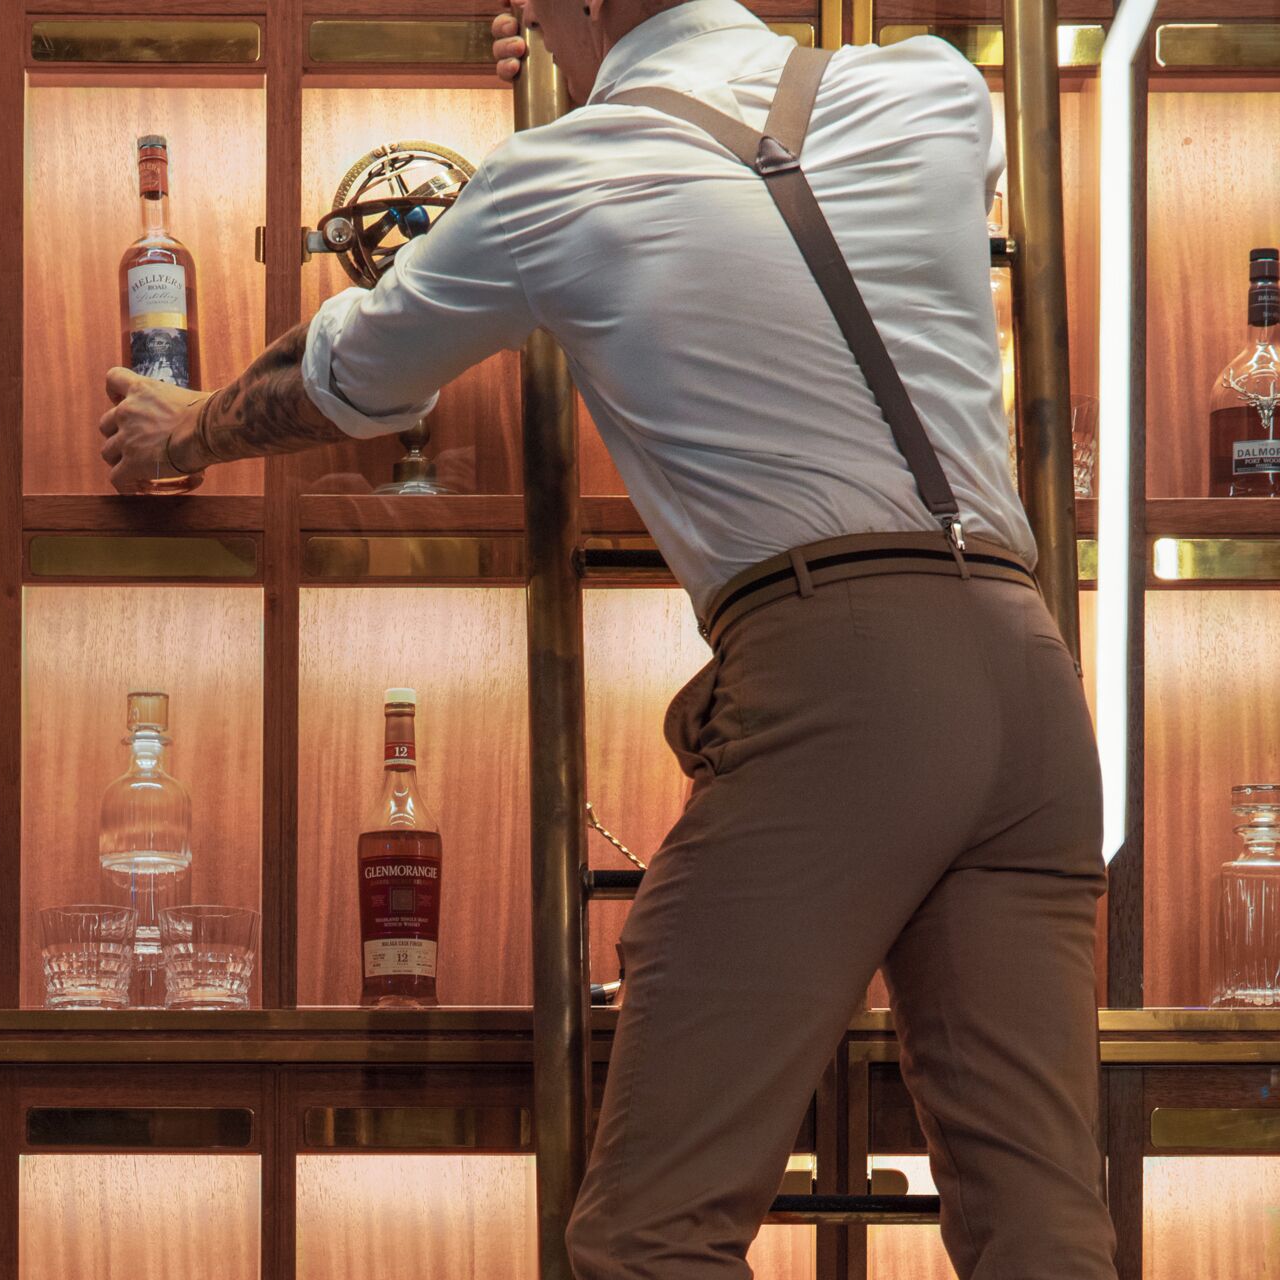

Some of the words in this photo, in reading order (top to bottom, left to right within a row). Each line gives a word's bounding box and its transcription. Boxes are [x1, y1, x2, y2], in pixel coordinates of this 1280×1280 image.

[131, 274, 183, 292] HELLYERS
[364, 864, 438, 879] GLENMORANGIE
[396, 952, 409, 963] 12
